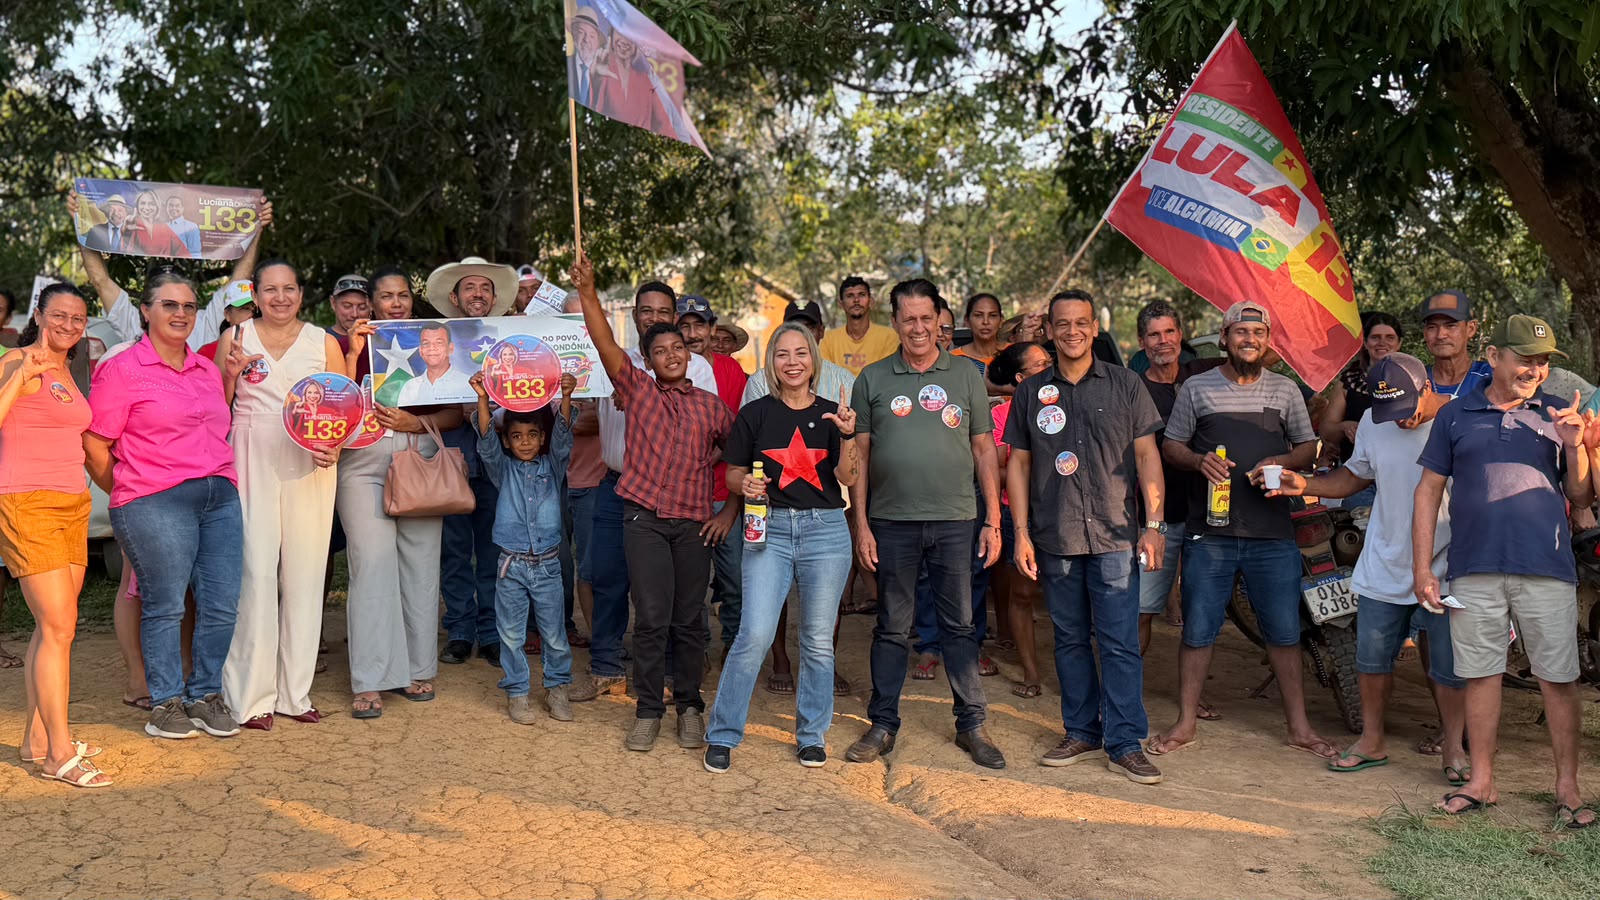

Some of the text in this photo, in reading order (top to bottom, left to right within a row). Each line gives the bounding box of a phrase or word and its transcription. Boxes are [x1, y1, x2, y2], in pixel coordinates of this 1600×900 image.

[1151, 127, 1302, 228] LULA
[198, 197, 234, 208] Luciana
[1147, 187, 1247, 239] VICE ALCKMIN
[198, 205, 257, 233] 133
[1305, 231, 1354, 303] 13
[552, 342, 593, 351] ONDÔNIA.
[556, 334, 580, 343] POVO,
[503, 378, 546, 399] 133
[304, 419, 347, 440] 133
[360, 413, 380, 434] 3
[1317, 576, 1338, 586] BRASIL
[1317, 582, 1349, 600] OXL
[1319, 594, 1359, 616] 6J86
